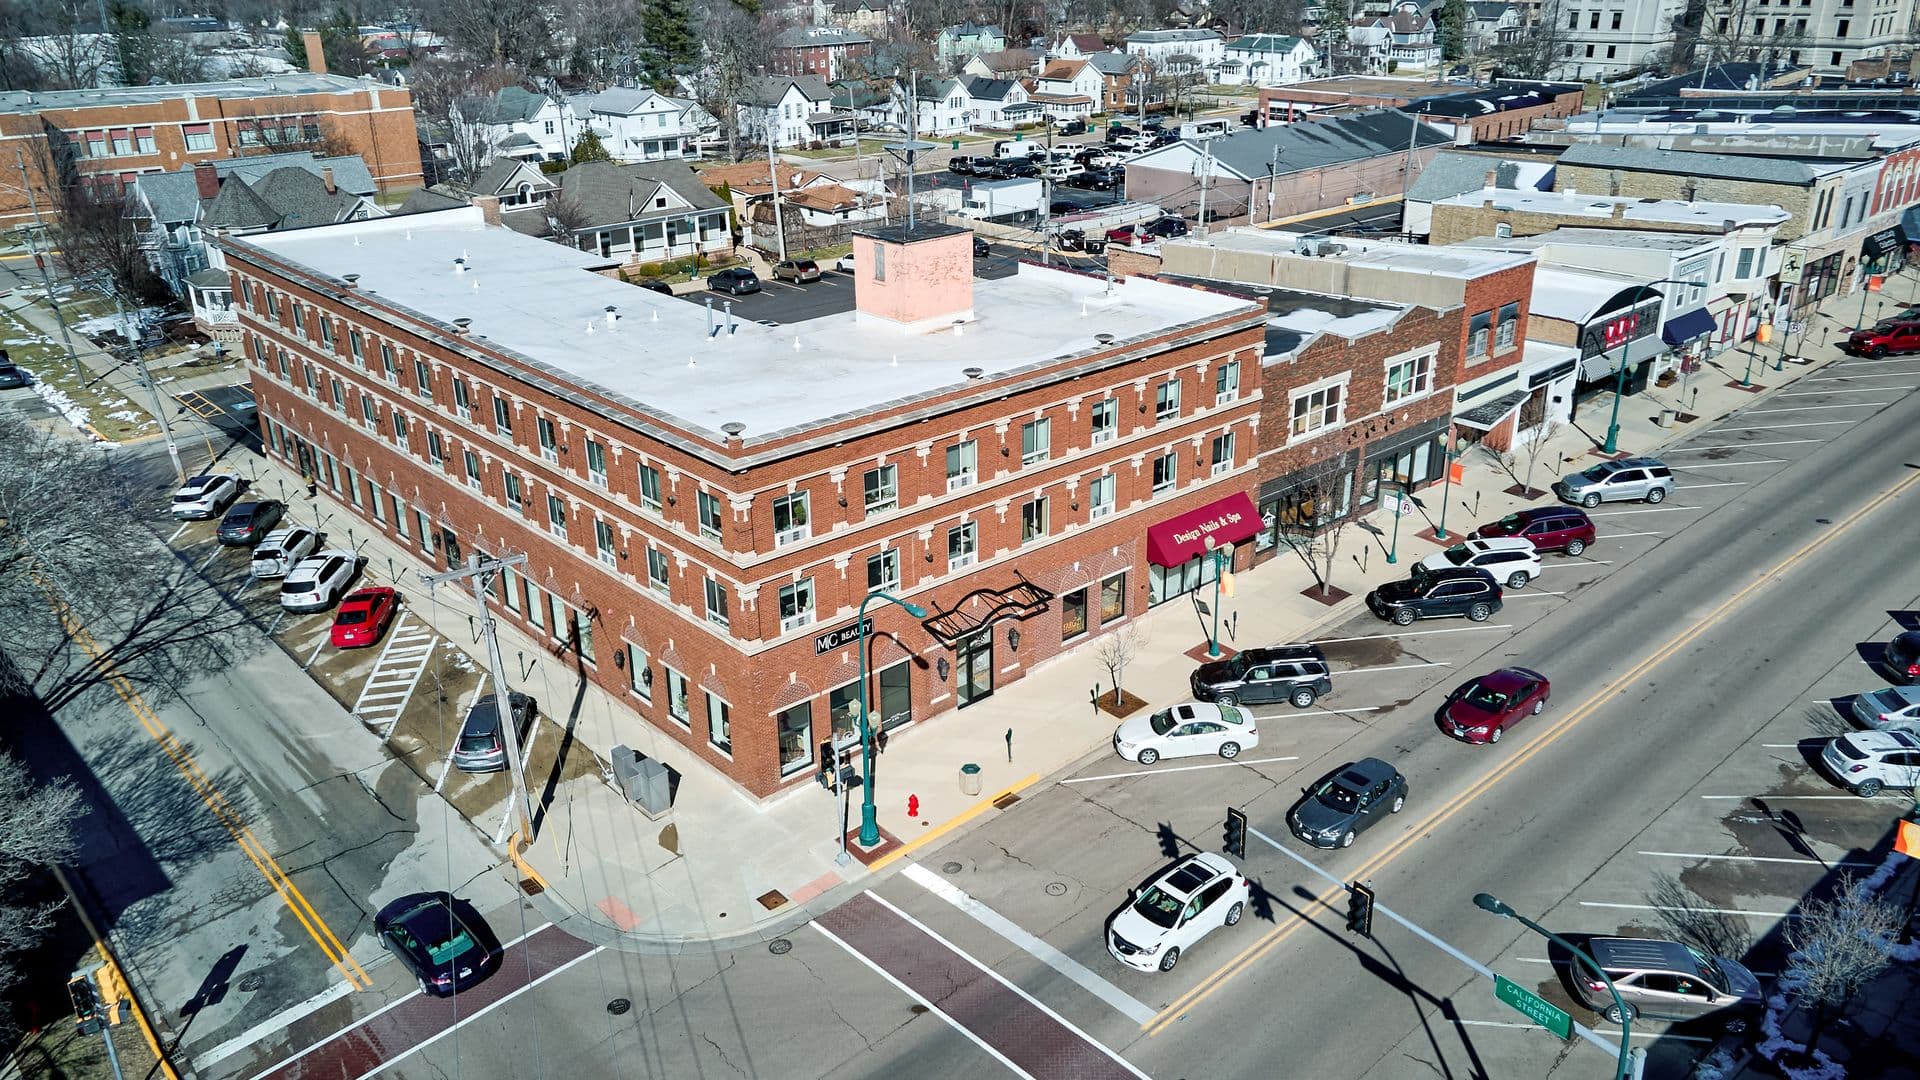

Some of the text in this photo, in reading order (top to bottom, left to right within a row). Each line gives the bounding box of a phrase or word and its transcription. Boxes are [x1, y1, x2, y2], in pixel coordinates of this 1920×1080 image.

[1174, 512, 1242, 545] Design Nails & Spa
[1506, 984, 1561, 1022] CALIFORNIA
[1515, 999, 1550, 1025] STREET
